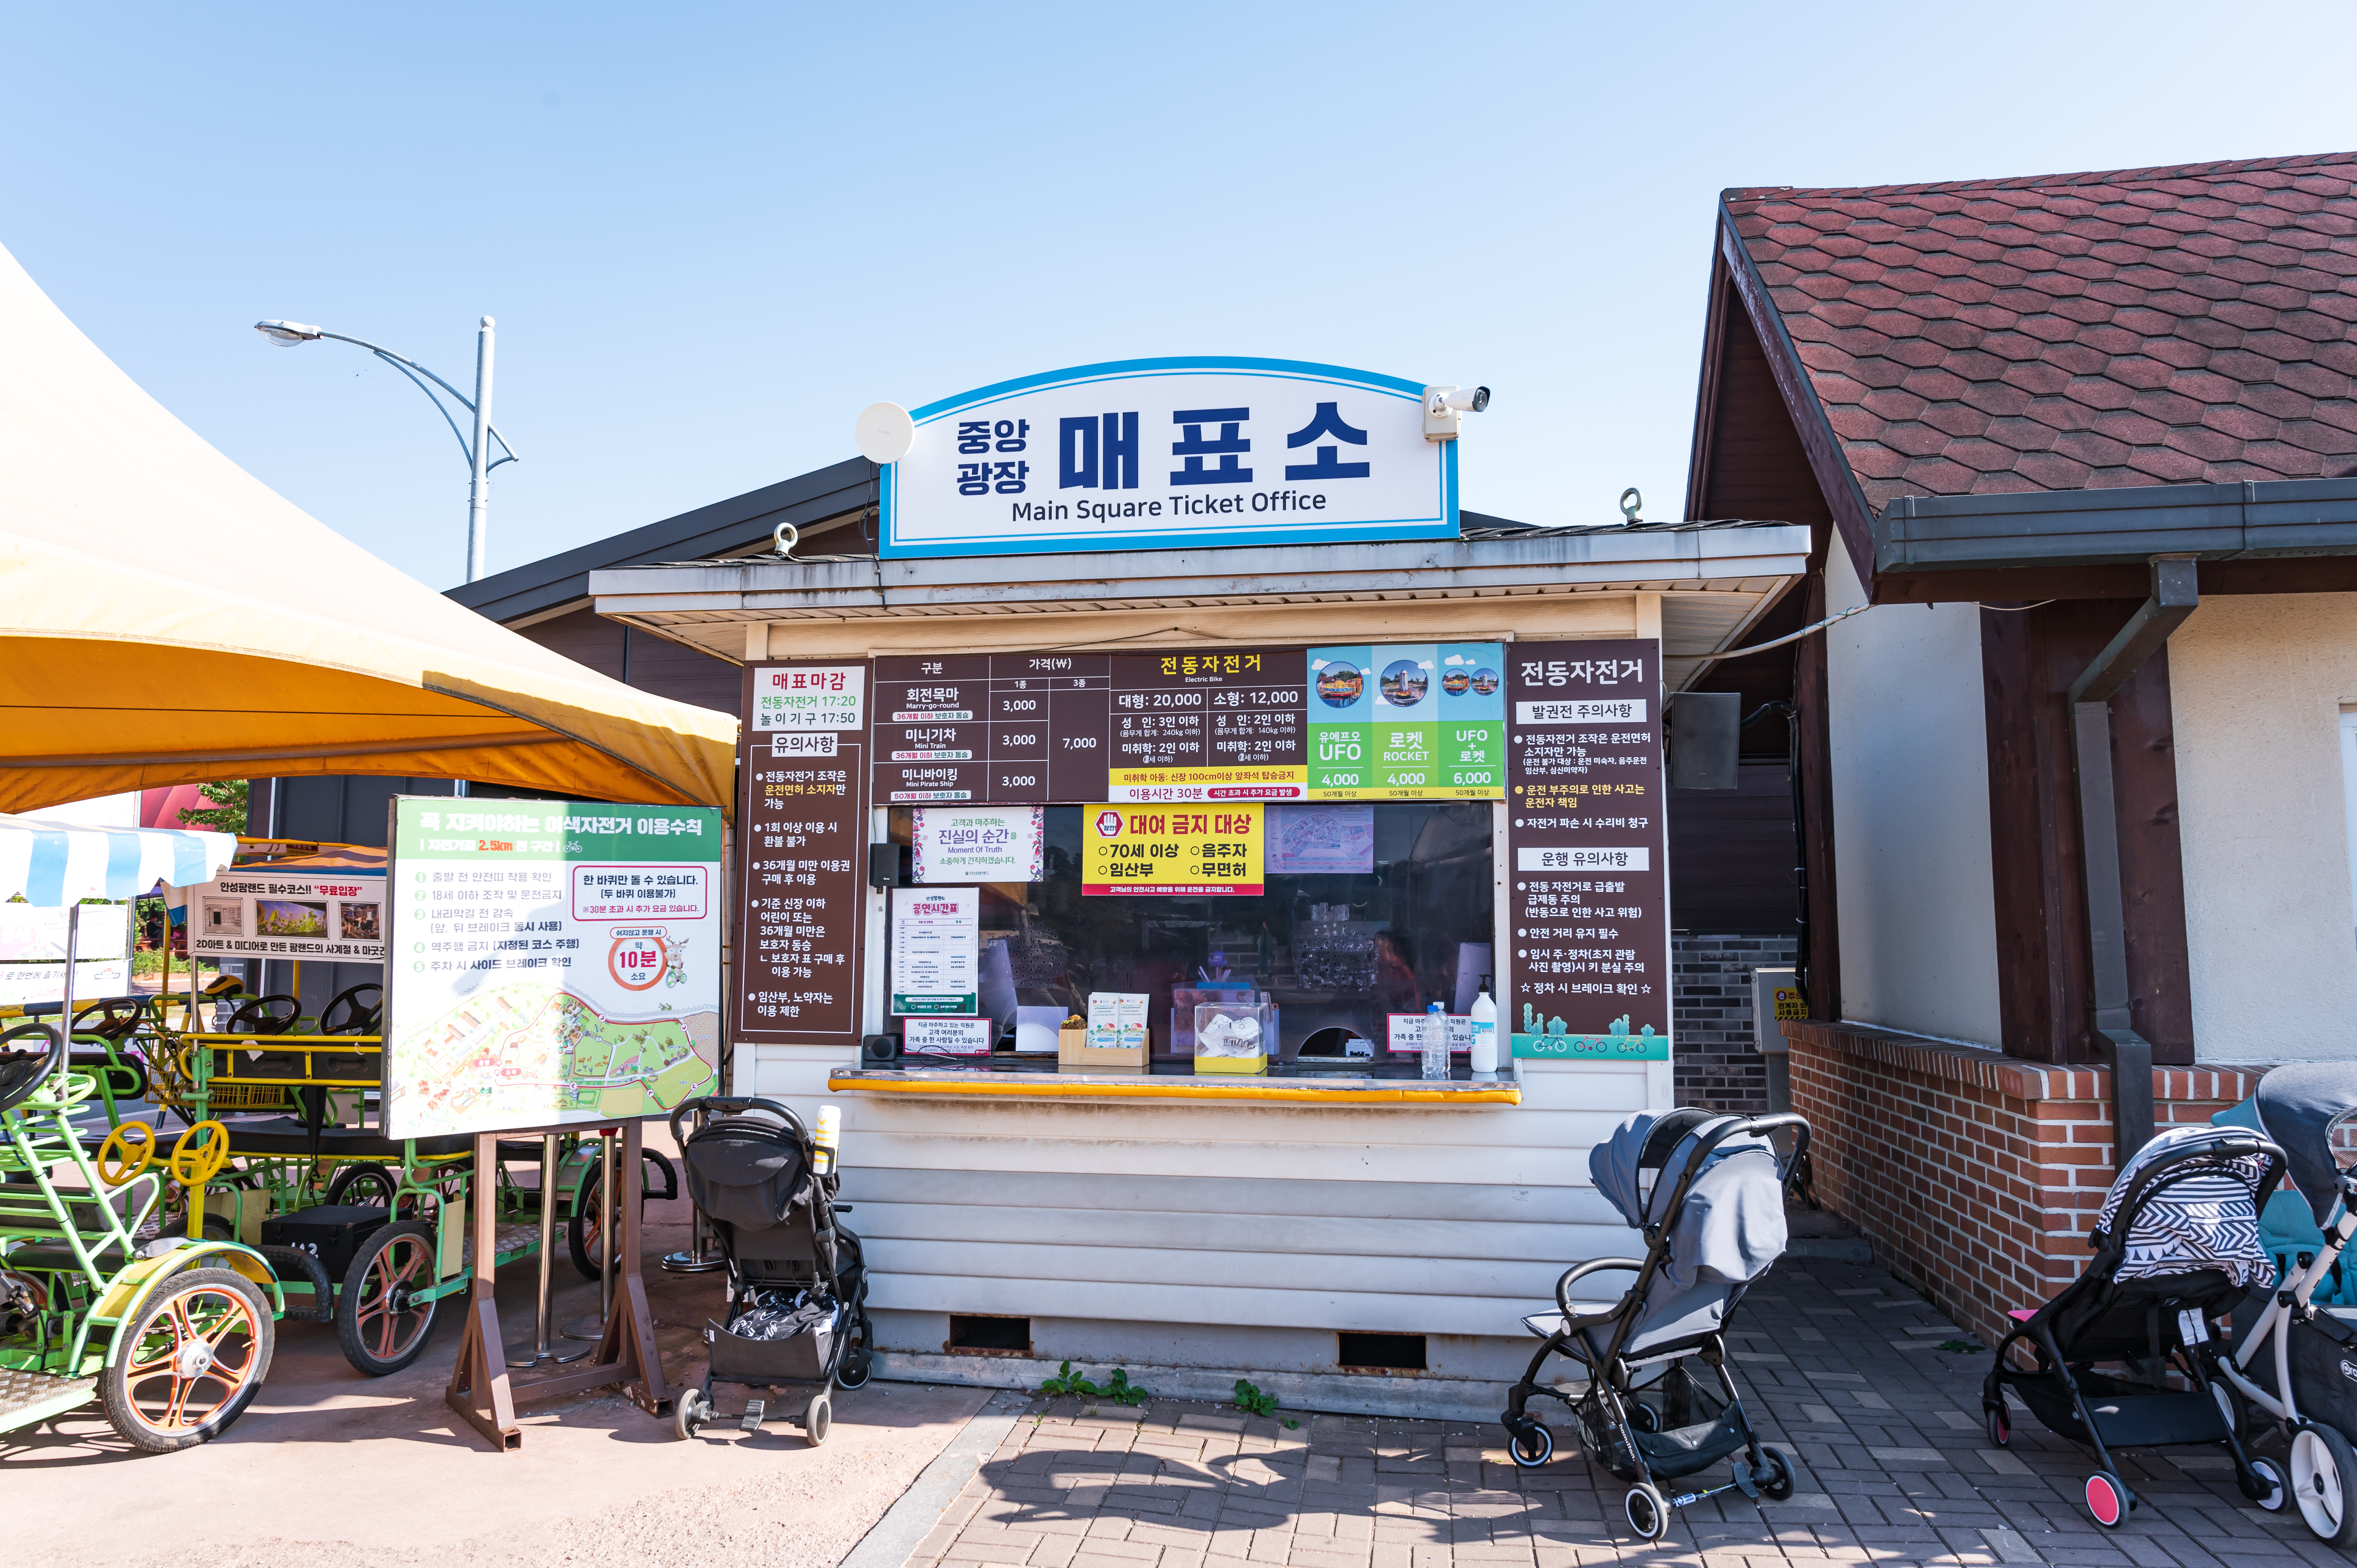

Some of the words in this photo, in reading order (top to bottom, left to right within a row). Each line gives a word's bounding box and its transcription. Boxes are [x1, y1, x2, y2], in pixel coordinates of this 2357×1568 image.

[958, 419, 1030, 454] 중앙
[1060, 402, 1369, 490] 매표소
[957, 461, 1029, 496] 광장
[1013, 501, 1067, 521] Main
[1077, 500, 1161, 523] Square
[1169, 494, 1243, 515] Ticket
[1252, 491, 1325, 512] Office
[921, 662, 942, 674] 구분
[1161, 654, 1260, 675] 전동자전거
[1521, 659, 1642, 686] 전동자전거
[773, 673, 846, 690] 매표마감
[1074, 679, 1086, 687] 3종
[907, 687, 959, 702] 회전목마
[1119, 694, 1148, 708] 대형:
[1154, 694, 1201, 707] 20,000
[1214, 692, 1244, 706] 소형:
[1250, 691, 1298, 705] 12,000
[762, 696, 817, 709] 전동자전거
[822, 696, 855, 706] 17:20
[1003, 700, 1036, 712] 3,000
[1533, 705, 1572, 719] 발권전
[1578, 704, 1632, 718] 주의사항
[761, 713, 816, 726] 놀이기구
[822, 713, 855, 723] 17:50
[906, 728, 956, 742] 미니기차
[1003, 735, 1035, 747] 3,000
[1319, 732, 1361, 742] 유에프오
[1388, 730, 1424, 751] 로켓
[1456, 730, 1487, 741] UFO
[775, 736, 834, 753] 유의사항
[1063, 738, 1096, 750] 7,000
[1320, 744, 1361, 760] UFO
[1384, 751, 1429, 761] ROCKET
[1459, 750, 1484, 763] 로켓
[766, 771, 814, 782] 전동자전거
[817, 770, 846, 782] 조작은
[903, 768, 957, 780] 미니바이킹
[1322, 774, 1359, 787] 4,000
[1387, 773, 1425, 786] 4,000
[1454, 772, 1491, 786] 6,000
[1002, 776, 1035, 787] 3,000
[765, 784, 803, 795] 운전면허
[807, 784, 846, 795] 소지자만
[1130, 788, 1173, 800] 이용시간
[1177, 788, 1203, 799] 30분
[765, 798, 784, 809] 가능
[421, 812, 440, 831] 꼭
[446, 813, 539, 833] 지켜야하는
[545, 816, 632, 834] 이색자전거
[637, 818, 702, 836] 이용수칙
[975, 818, 1005, 826] 마주하는
[1131, 815, 1164, 834] 대여
[1172, 815, 1207, 834] 금지
[1215, 814, 1251, 834] 대상
[939, 830, 978, 844] 진실의
[479, 840, 512, 851] 2.5km
[516, 841, 527, 852] 전
[530, 841, 553, 852] 구간
[1110, 844, 1144, 858] 70세
[1150, 844, 1179, 858] 이상
[1202, 844, 1247, 858] 음주자
[1542, 852, 1567, 866] 운행
[1573, 852, 1628, 866] 유의사항
[1110, 863, 1153, 877] 임산부
[1202, 863, 1246, 877] 무면허
[584, 875, 594, 885] 한
[597, 876, 628, 885] 바퀴만
[631, 876, 640, 885] 돌
[644, 876, 653, 885] 수
[657, 876, 698, 885] 있습니다.
[221, 882, 265, 893] 안성팜랜드
[269, 884, 311, 894] 필수코스!!
[913, 903, 958, 915] 공연시간표
[196, 940, 224, 949] 2D아트
[227, 941, 232, 949] &
[235, 941, 268, 951] 미디어로
[270, 943, 287, 952] 만든
[290, 943, 323, 953] 팜랜드의
[326, 945, 351, 954] 사계절
[354, 945, 360, 954] &
[620, 951, 656, 968] 10분
[1534, 983, 1555, 994] 정차
[1558, 983, 1567, 993] 시
[1571, 983, 1613, 994] 브레이크
[1617, 984, 1637, 995] 확인
